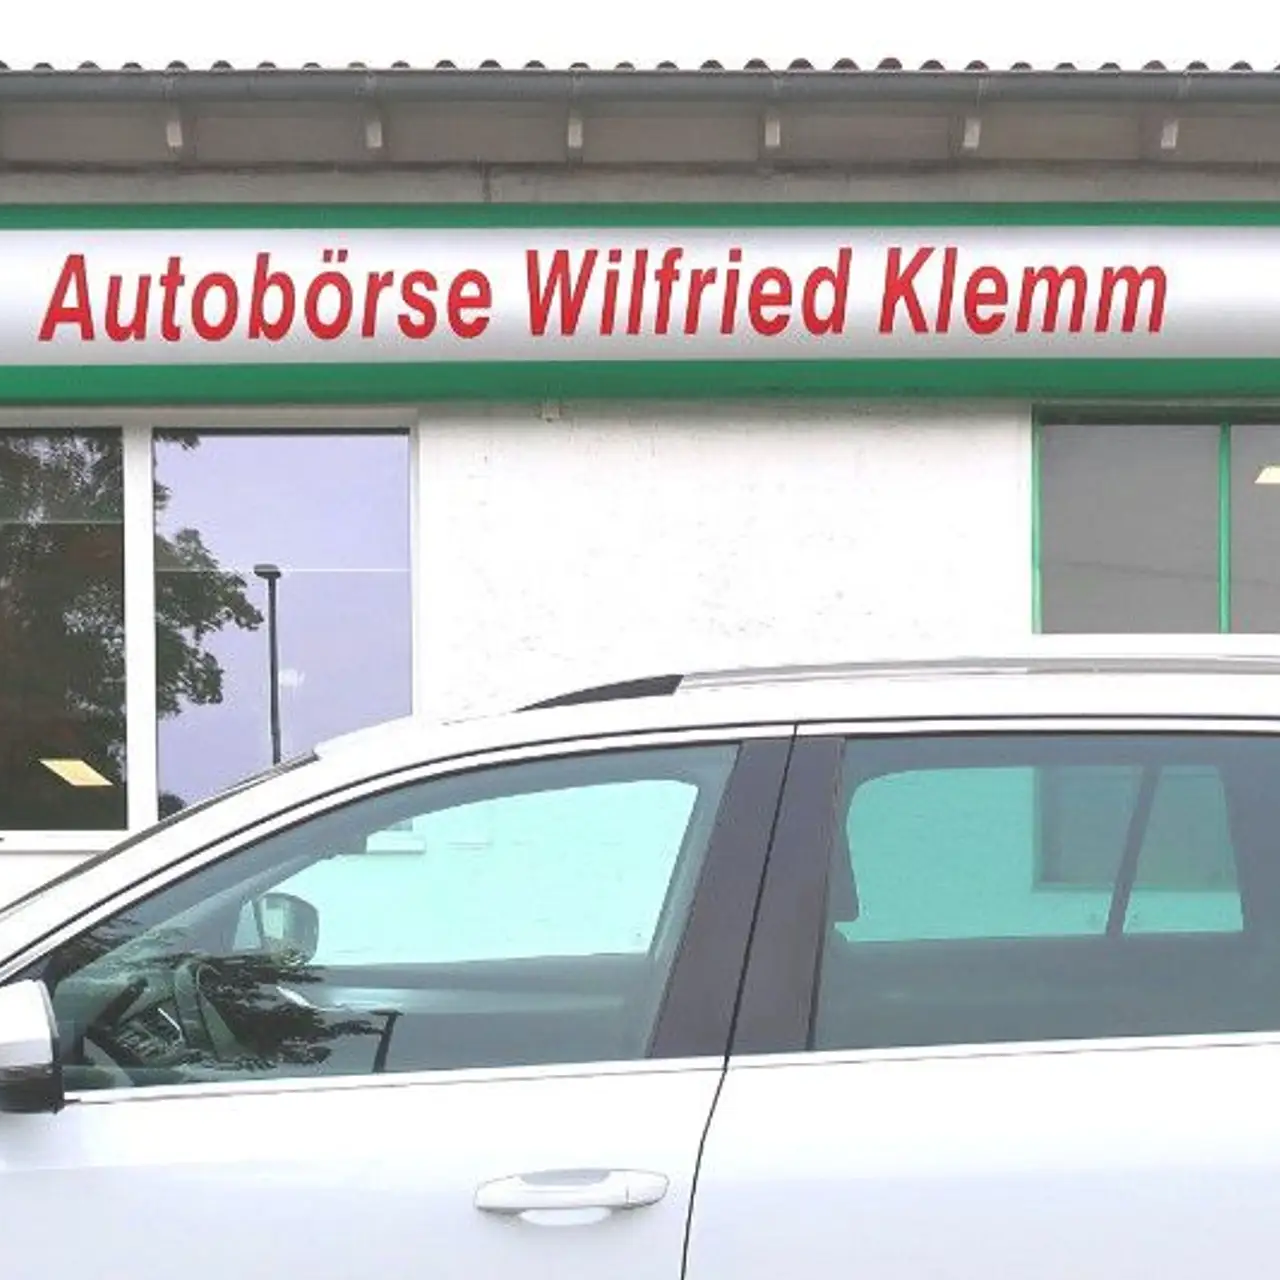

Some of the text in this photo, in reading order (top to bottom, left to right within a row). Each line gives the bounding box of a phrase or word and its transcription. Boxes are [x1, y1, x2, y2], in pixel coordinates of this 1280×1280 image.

[37, 245, 1168, 342] Autobörse Wilfried Klemm
